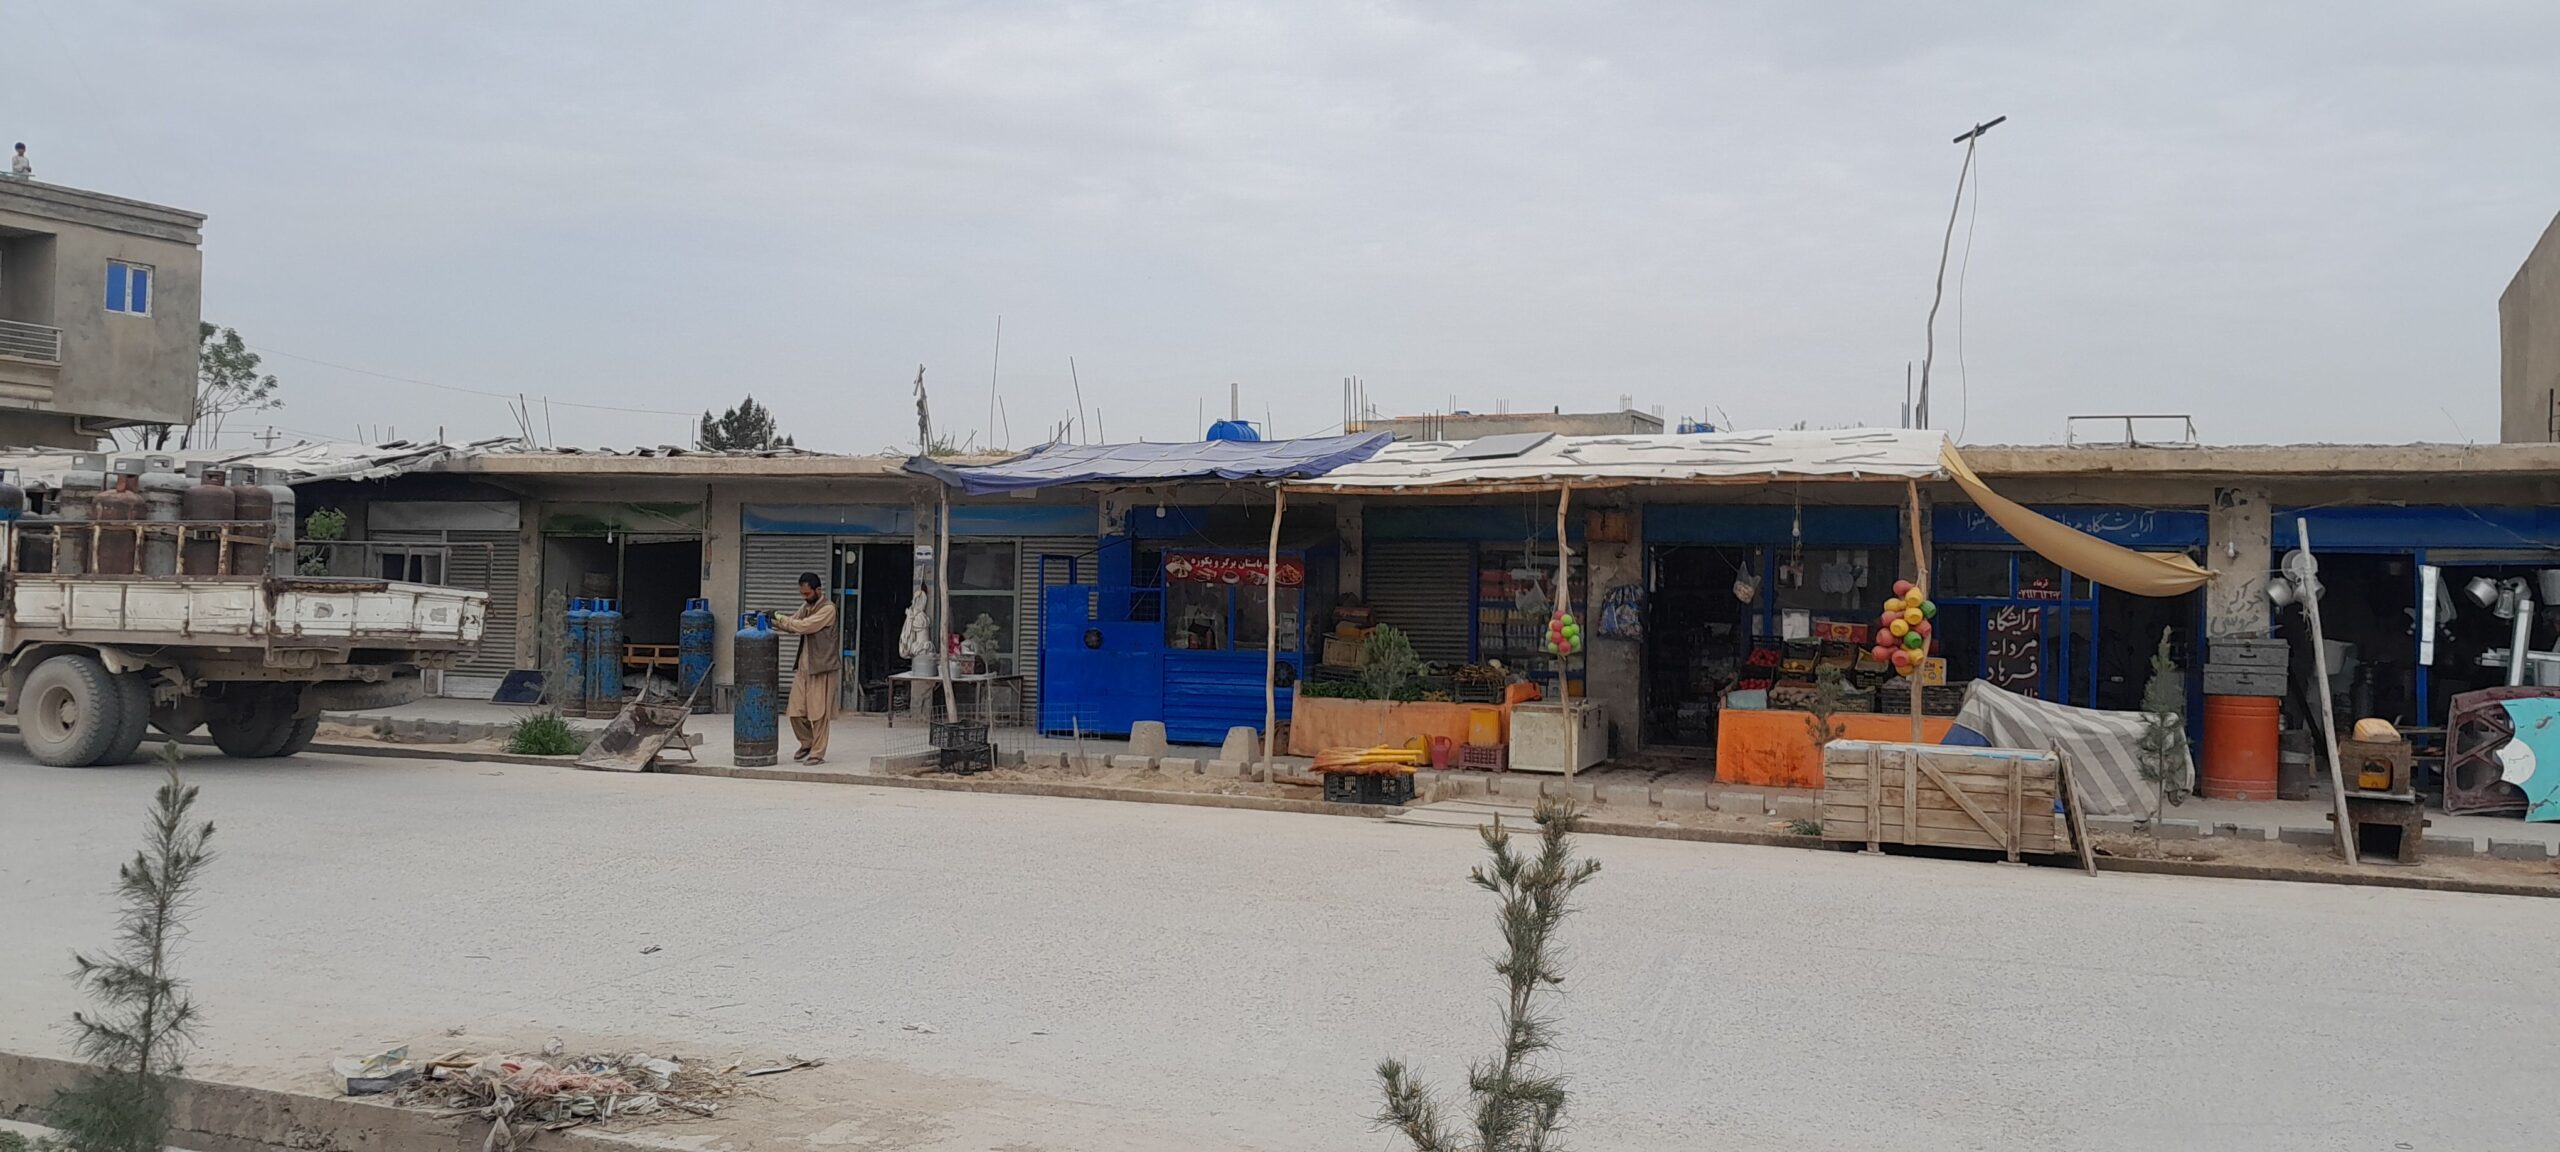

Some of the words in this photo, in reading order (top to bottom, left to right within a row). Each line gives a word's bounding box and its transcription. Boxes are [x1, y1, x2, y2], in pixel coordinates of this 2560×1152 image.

[2086, 510, 2156, 538] آرایشگاه
[1213, 560, 1219, 569] و
[1987, 605, 2040, 635] آرایشگاه
[1988, 638, 2038, 658] مردانه
[1987, 656, 2038, 687] فرهاد
